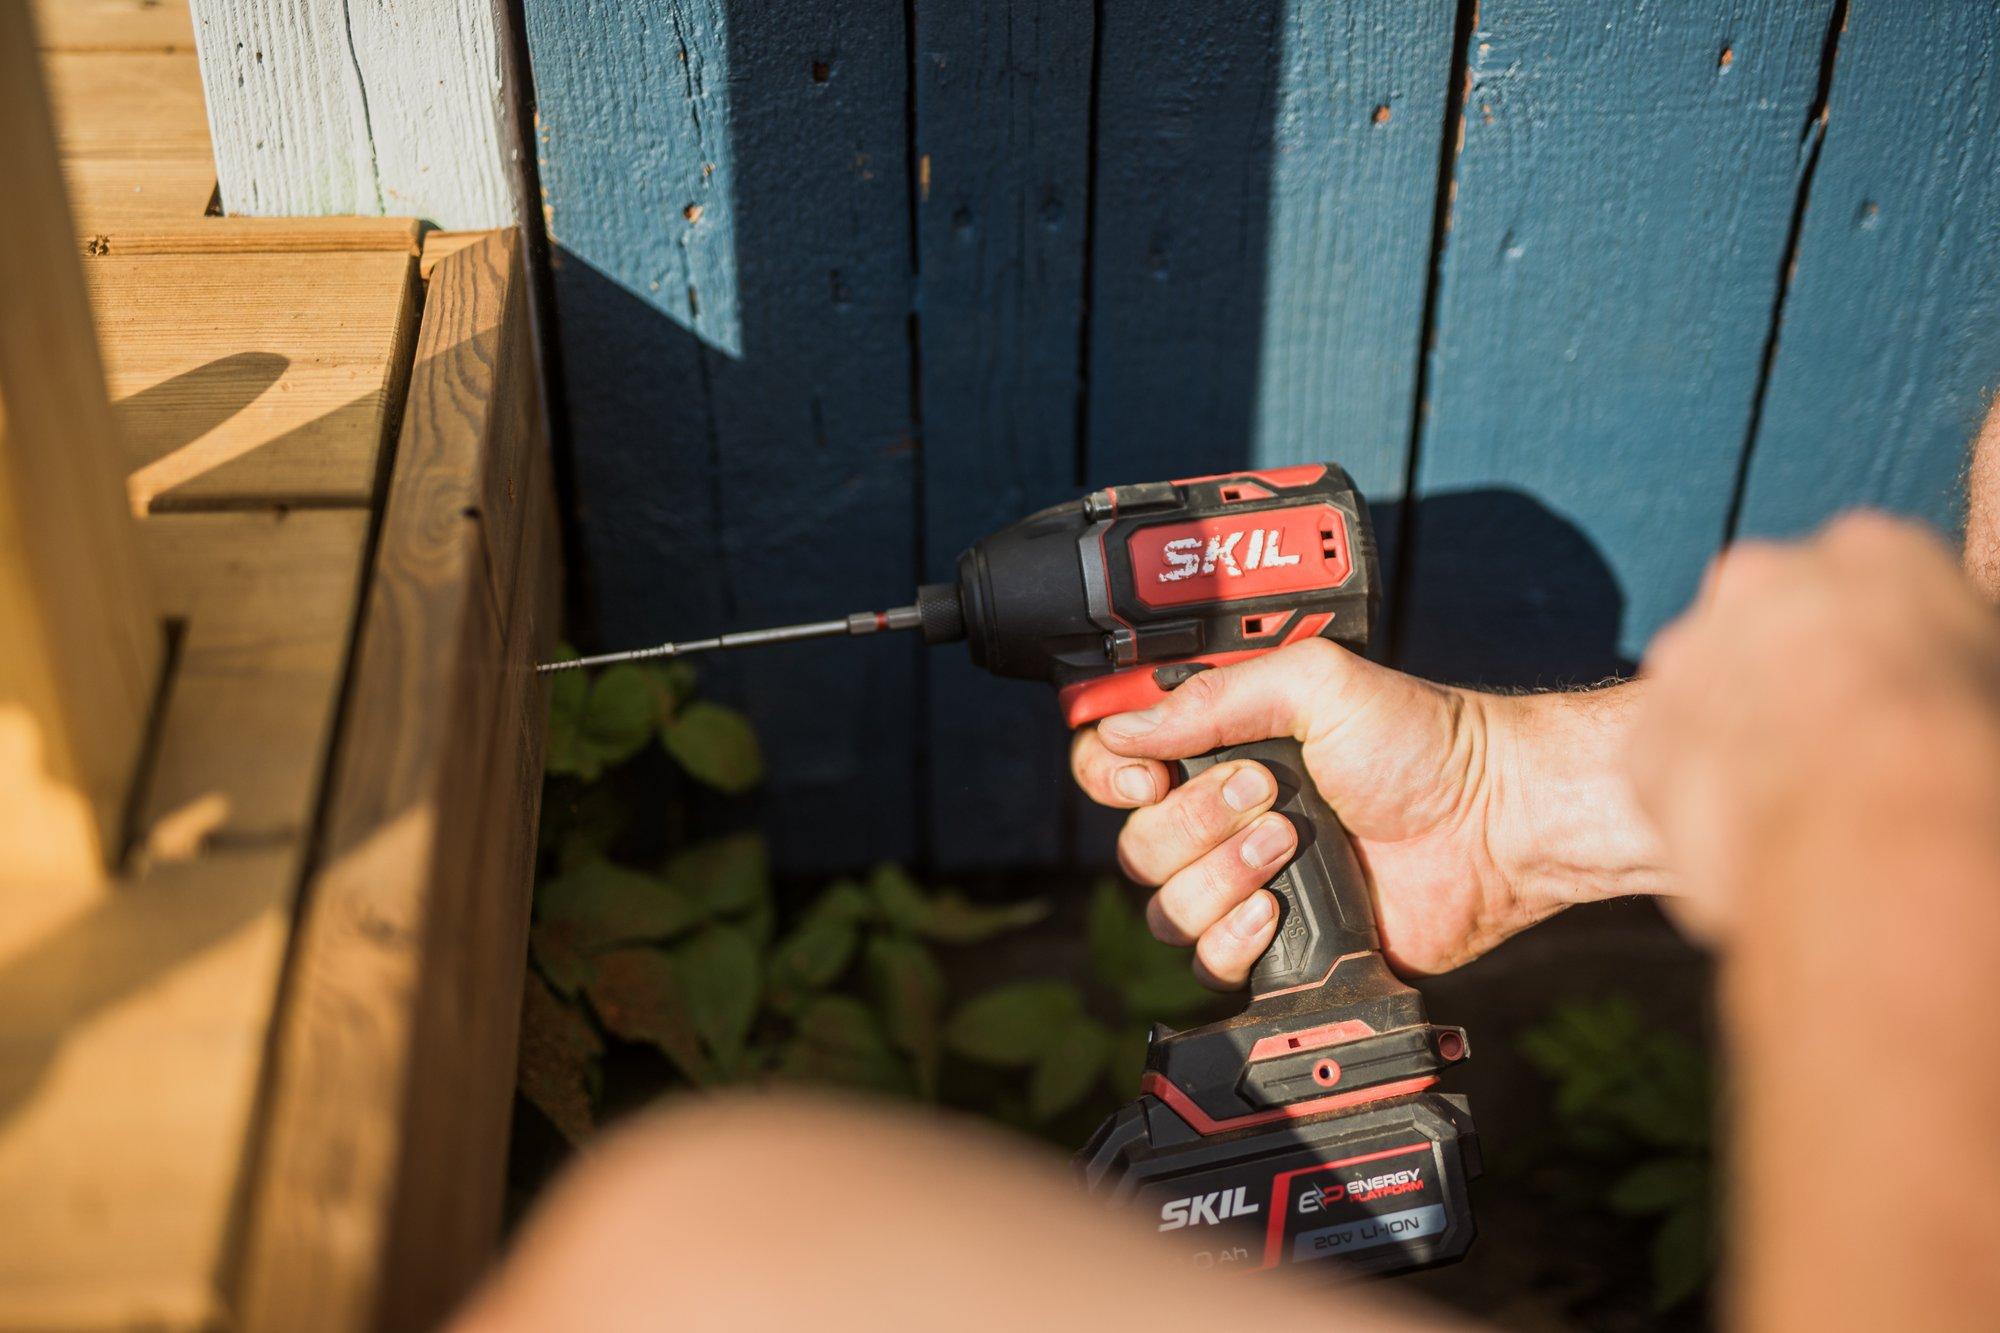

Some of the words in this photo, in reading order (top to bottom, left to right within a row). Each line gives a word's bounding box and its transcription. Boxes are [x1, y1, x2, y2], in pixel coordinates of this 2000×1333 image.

[1158, 527, 1301, 582] SKIL
[1346, 1168, 1420, 1194] ENERGY
[1348, 1179, 1424, 1203] PLATFORM
[1158, 1186, 1260, 1233] SKIL
[1314, 1230, 1353, 1250] 20V
[1361, 1217, 1420, 1239] LI-ION
[1220, 1247, 1248, 1264] Ah
